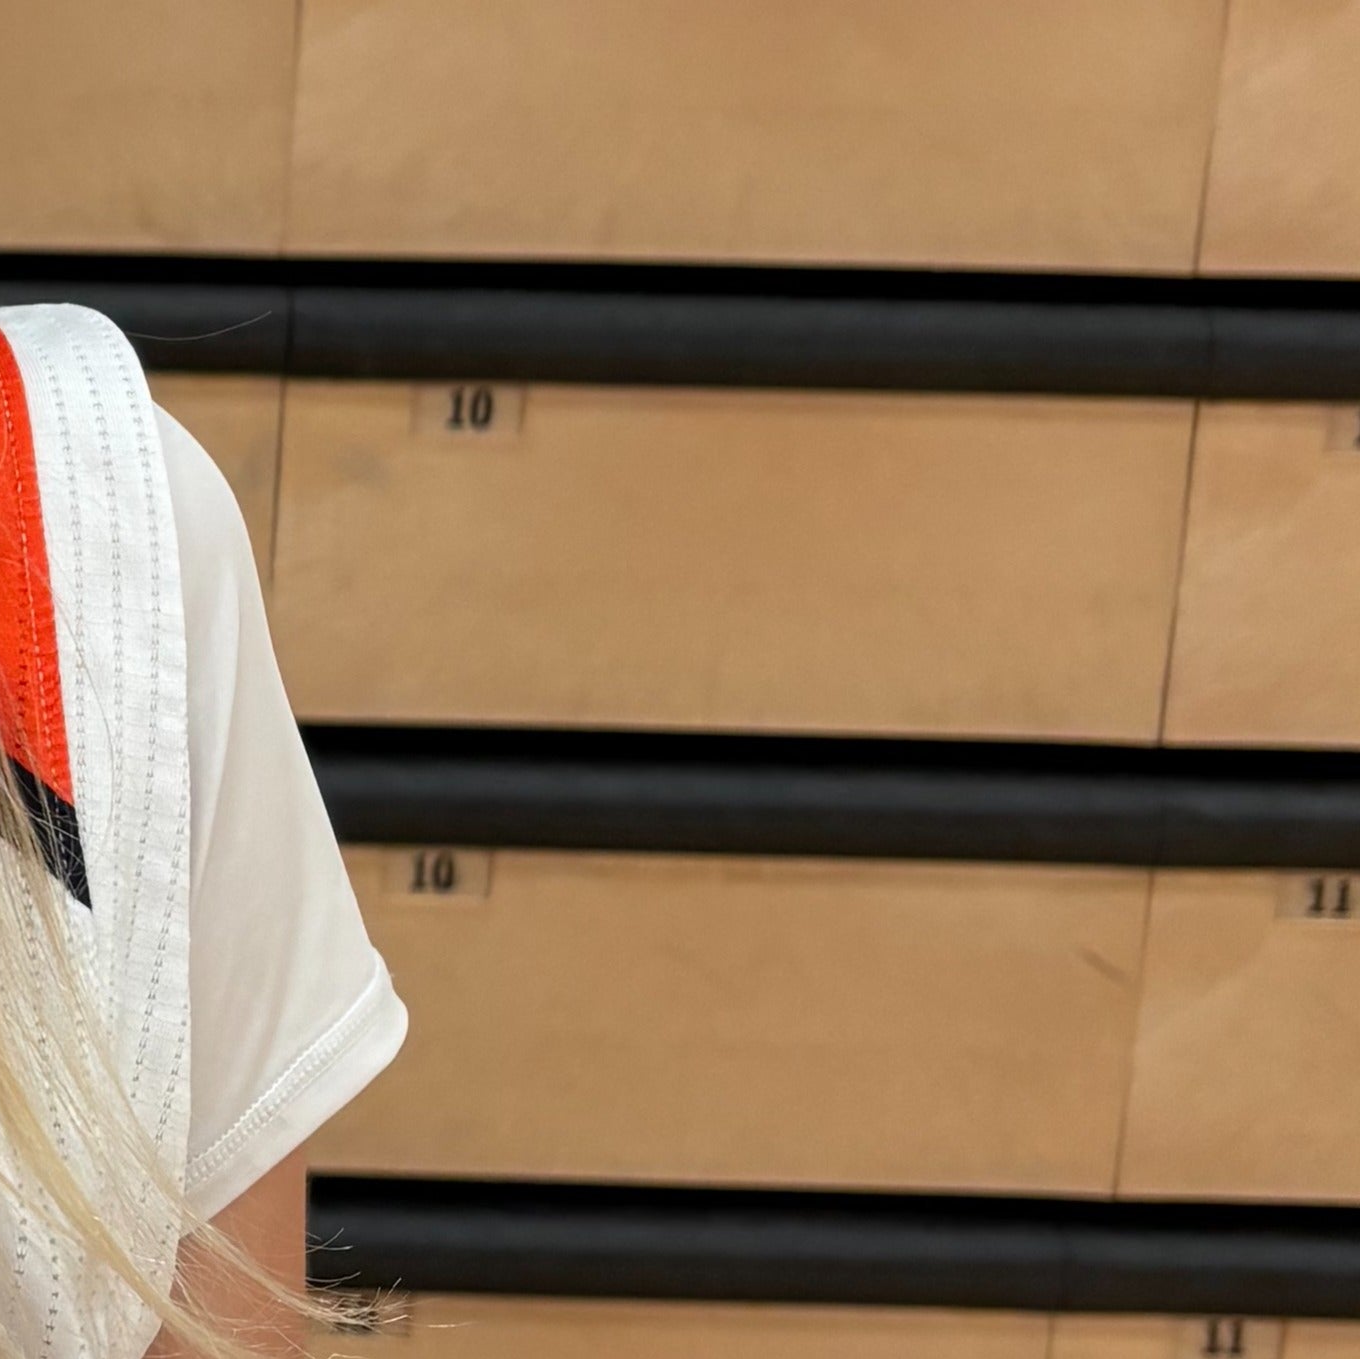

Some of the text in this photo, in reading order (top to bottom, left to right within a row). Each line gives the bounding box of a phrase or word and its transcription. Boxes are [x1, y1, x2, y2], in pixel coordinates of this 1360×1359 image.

[447, 385, 494, 430] 10
[410, 850, 455, 893] 10
[1304, 873, 1351, 919] 11
[1201, 1316, 1242, 1354] 11
